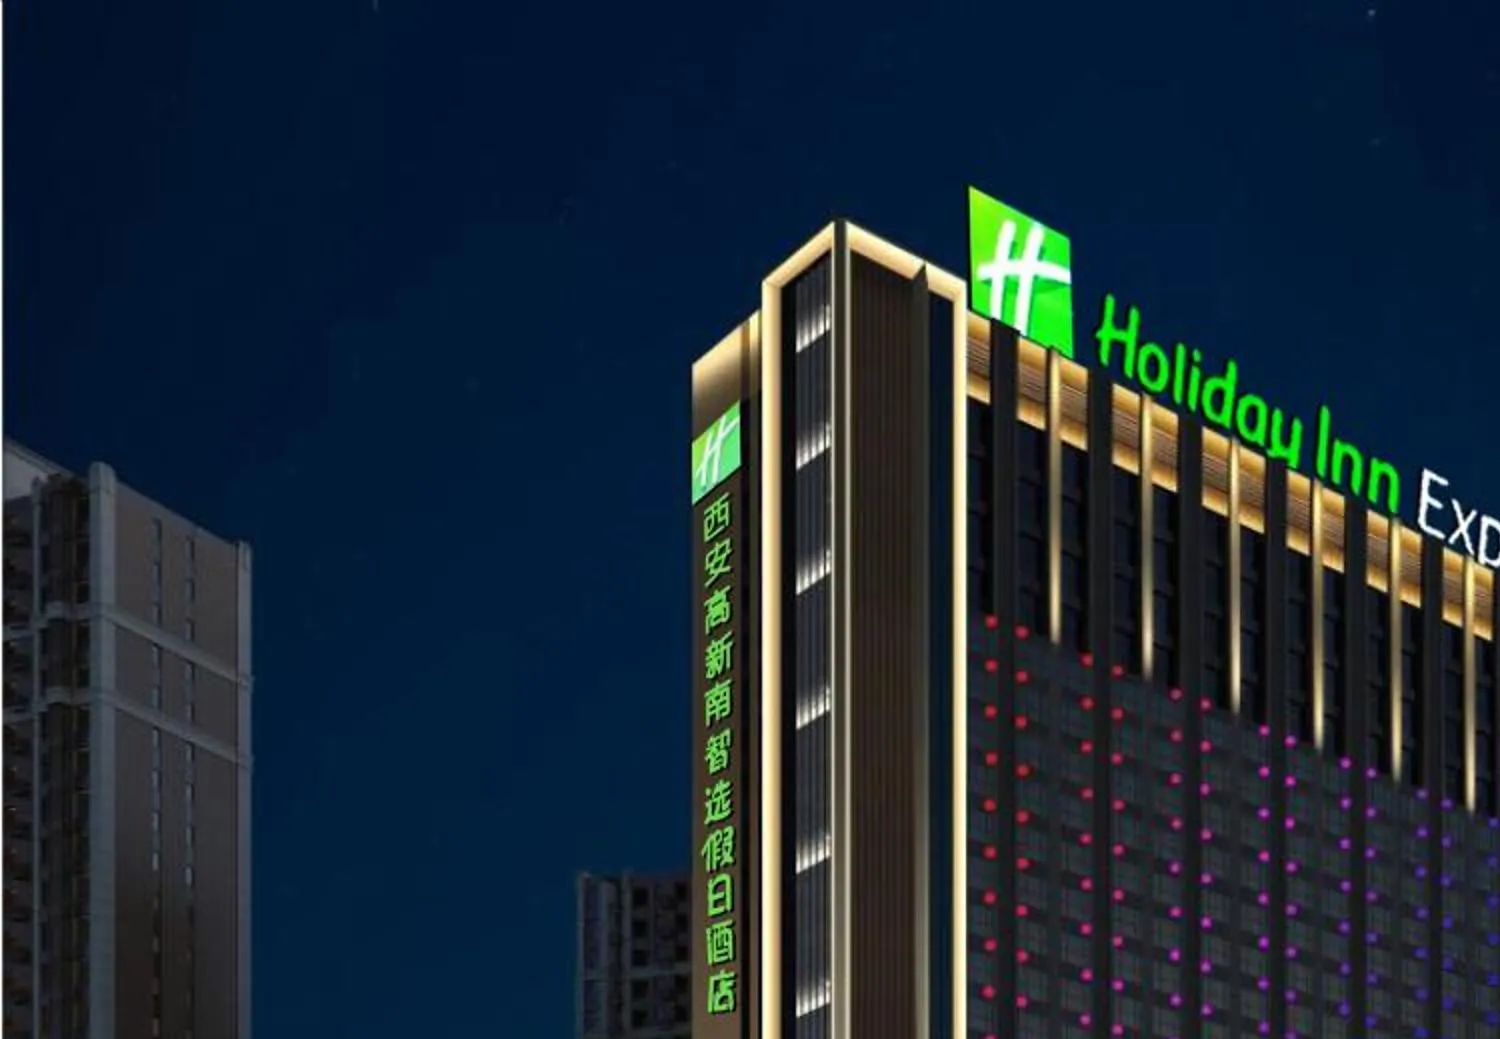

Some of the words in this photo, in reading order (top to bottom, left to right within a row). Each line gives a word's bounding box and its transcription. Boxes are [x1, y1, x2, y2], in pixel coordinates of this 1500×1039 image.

[1095, 293, 1303, 469] Holiday
[1316, 404, 1400, 515] Inn
[702, 492, 737, 1014] 西安高新南智选假日酒店
